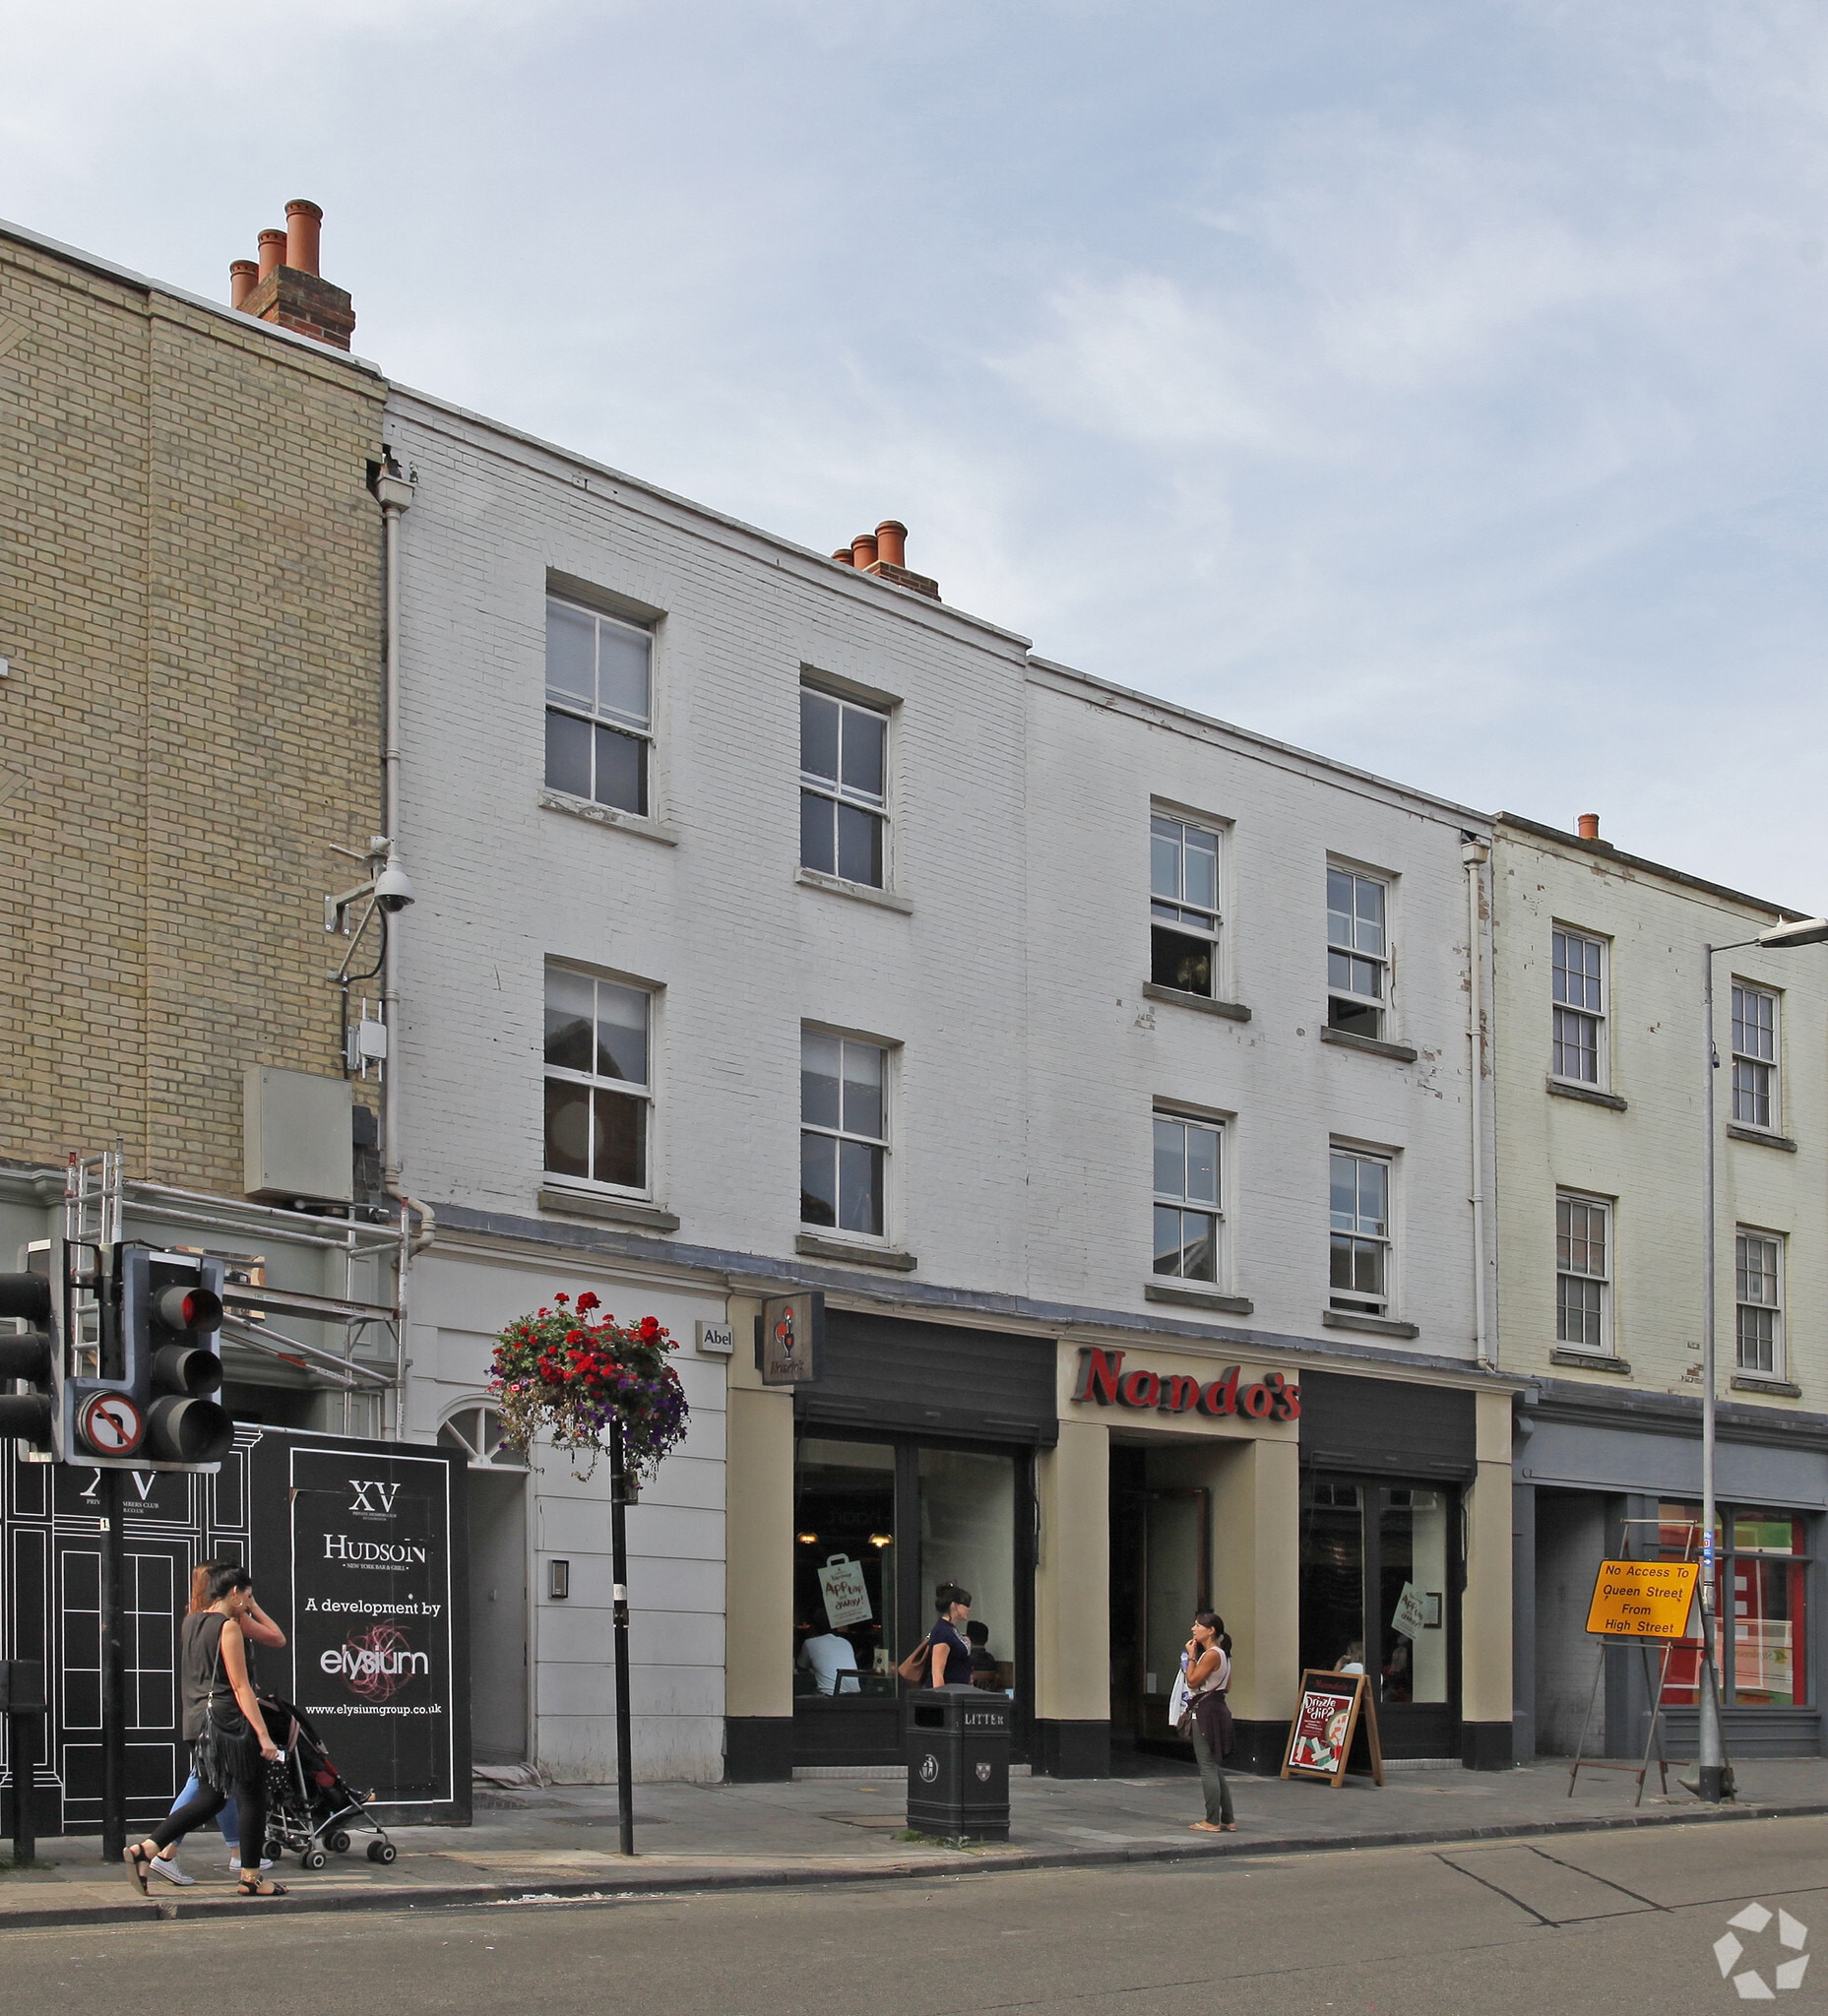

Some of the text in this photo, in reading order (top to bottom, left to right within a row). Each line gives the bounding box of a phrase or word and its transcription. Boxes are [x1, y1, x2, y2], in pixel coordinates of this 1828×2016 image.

[704, 1329, 732, 1346] Abel
[1070, 1347, 1302, 1421] Nando's
[348, 1480, 401, 1513] XV
[1606, 1565, 1689, 1578] No Access To
[826, 1581, 863, 1597] App tap
[1604, 1584, 1683, 1599] Queen Street
[305, 1598, 441, 1616] A development by
[836, 1595, 863, 1610] away!
[1621, 1604, 1651, 1614] From
[1606, 1619, 1674, 1633] High Street
[320, 1644, 429, 1680] elysium
[1305, 1696, 1336, 1709] Drizzle
[305, 1704, 442, 1717] www.elysiumgroup.co.uk
[965, 1713, 1004, 1725] LITTER
